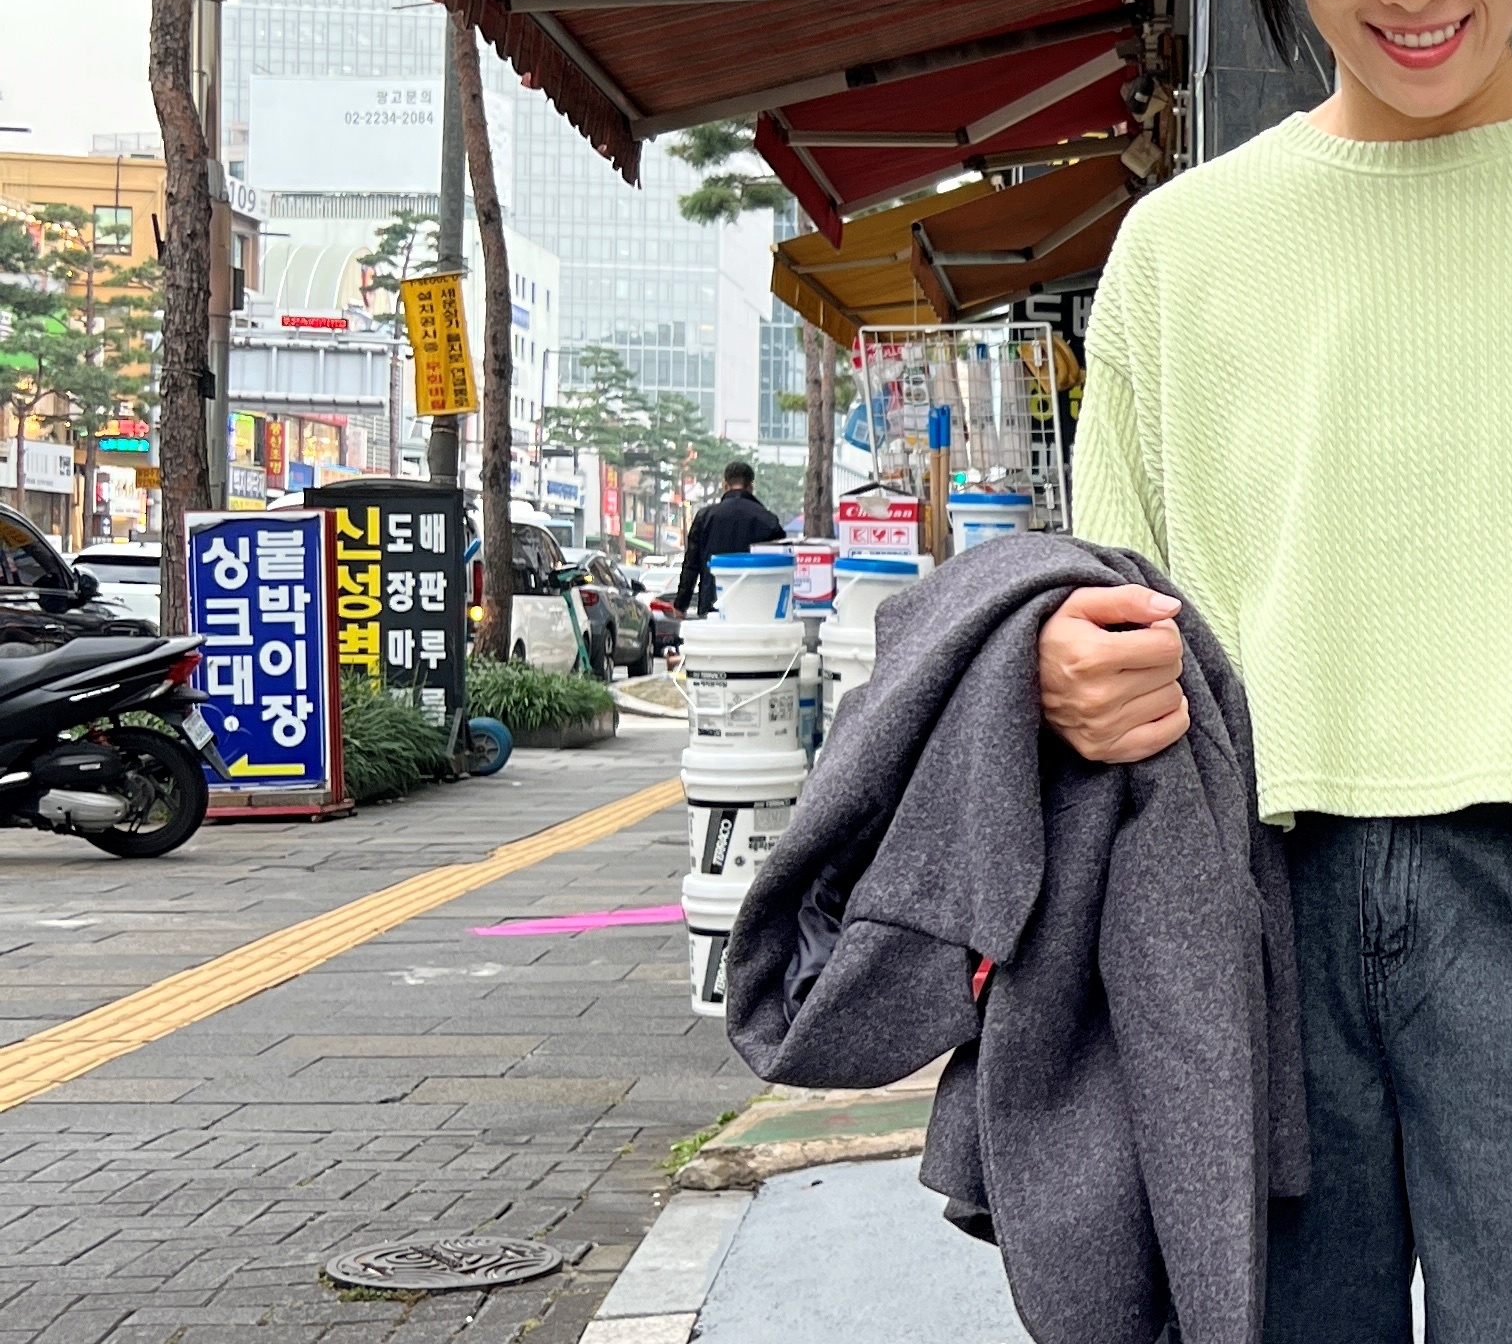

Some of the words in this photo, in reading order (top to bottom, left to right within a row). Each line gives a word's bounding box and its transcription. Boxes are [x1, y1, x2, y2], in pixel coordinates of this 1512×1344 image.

[344, 111, 434, 126] 02-2234-2084
[387, 513, 446, 553] 도배
[337, 506, 382, 692] 신성벽
[387, 571, 447, 613] 장판
[202, 537, 254, 705] 싱크대
[256, 530, 314, 748] 붙박이장
[387, 629, 447, 670] 마루
